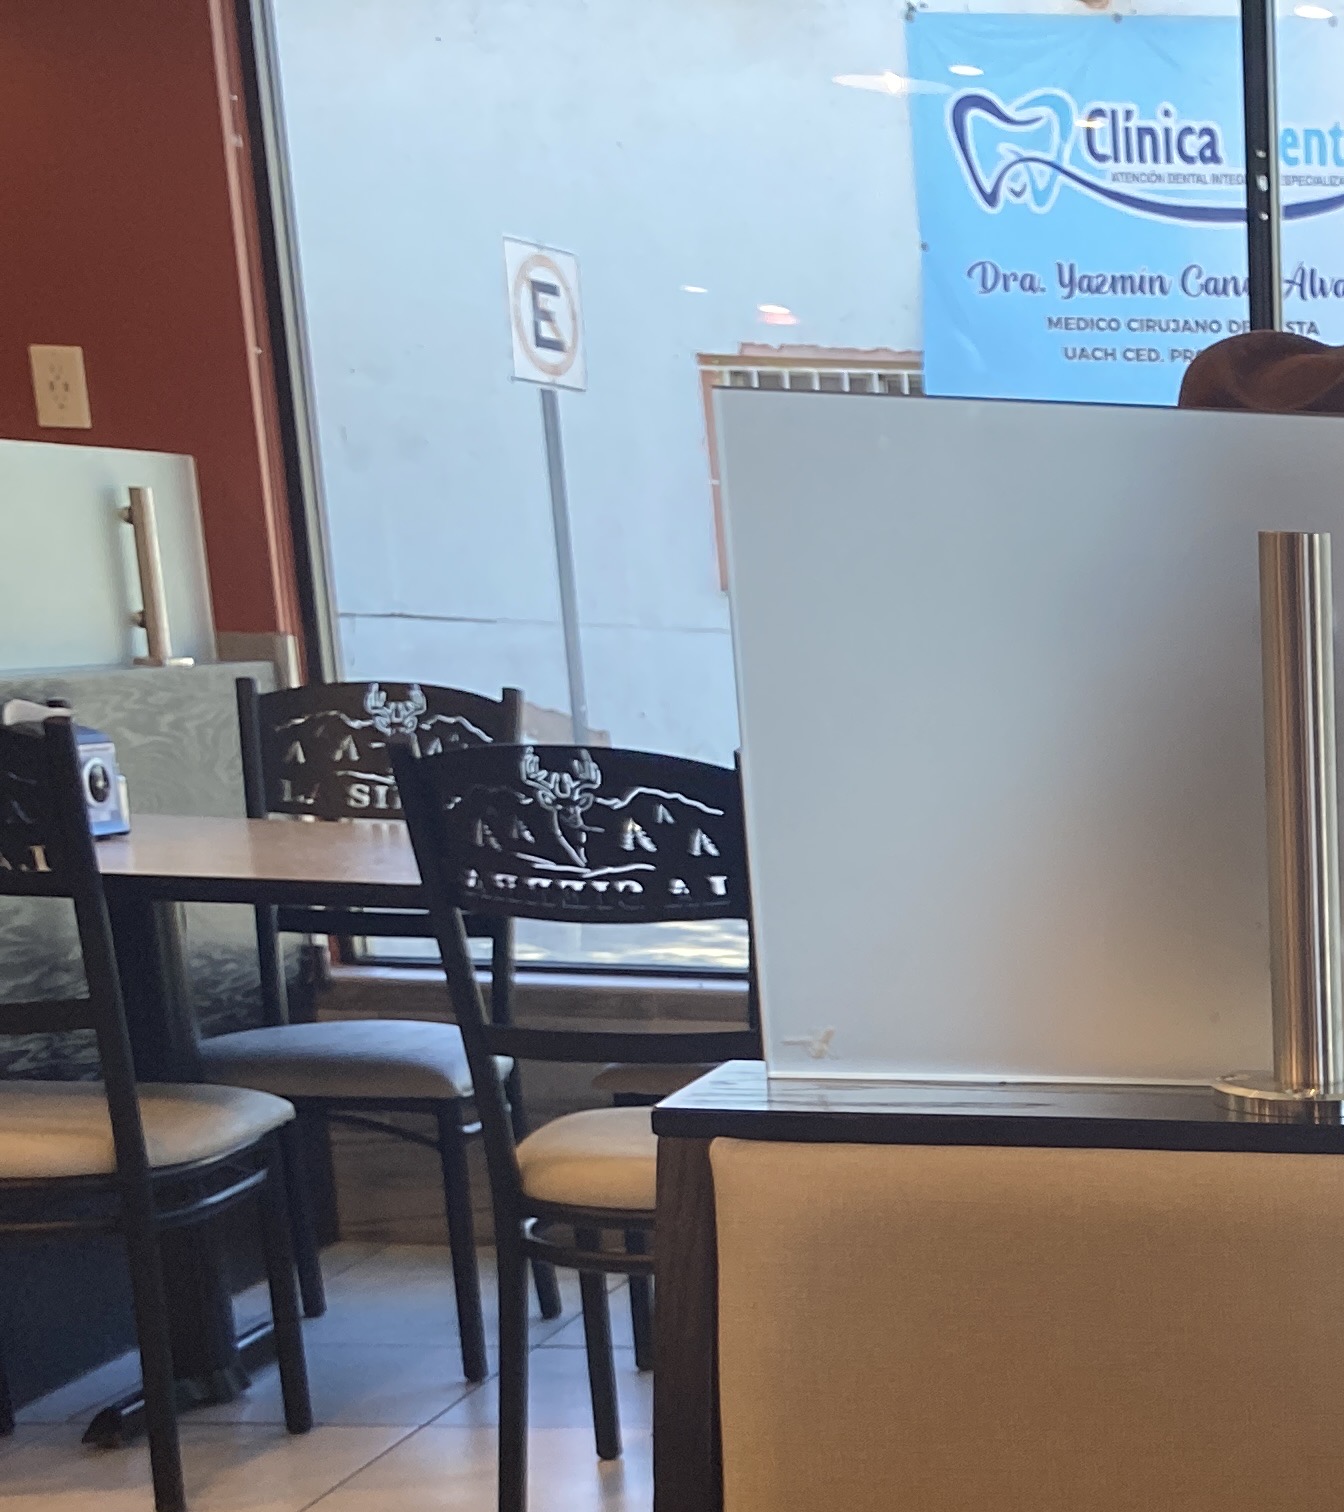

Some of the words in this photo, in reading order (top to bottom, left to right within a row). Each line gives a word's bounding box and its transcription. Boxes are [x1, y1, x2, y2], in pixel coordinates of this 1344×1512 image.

[1085, 107, 1223, 165] Clínica
[1210, 172, 1247, 186] INTEG
[966, 260, 1047, 295] Dra.
[1181, 263, 1249, 298] Can
[1047, 316, 1121, 332] MEDICO
[1127, 318, 1222, 335] CIRUJANO
[1228, 319, 1320, 337] DESTA
[1063, 346, 1117, 362] UACH
[1123, 347, 1164, 363] CED.
